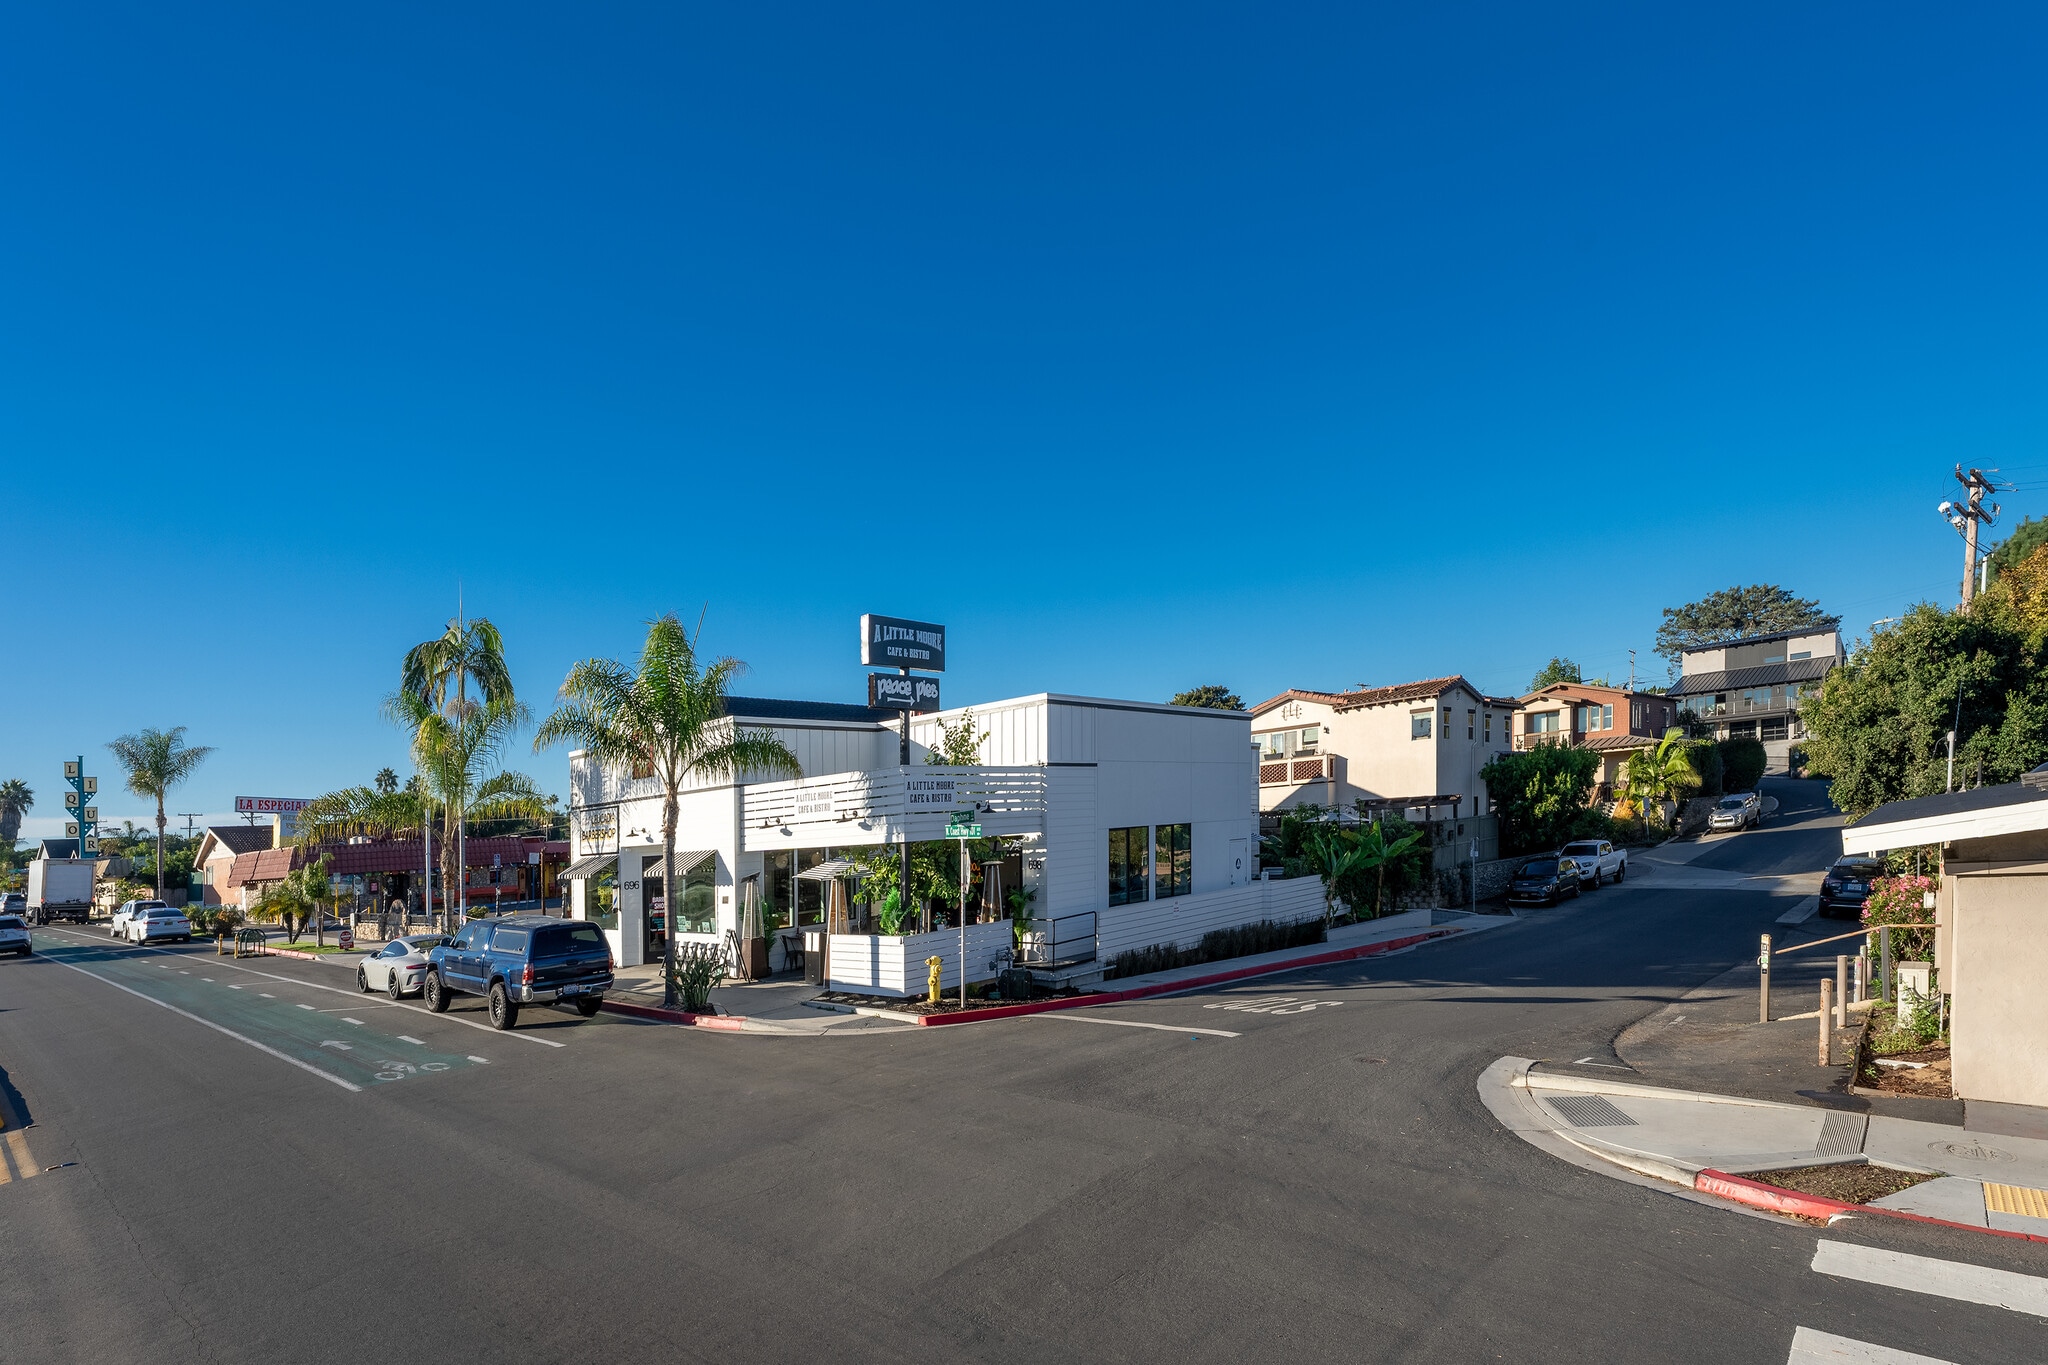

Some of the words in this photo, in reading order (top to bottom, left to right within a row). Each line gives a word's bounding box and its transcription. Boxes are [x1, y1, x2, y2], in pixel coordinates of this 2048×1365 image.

[874, 625, 881, 643] A
[883, 626, 914, 641] LITTLE
[916, 630, 942, 652] MOORE
[887, 646, 903, 657] CAFE
[903, 648, 909, 658] &
[909, 648, 930, 660] BISTRO
[877, 678, 912, 700] peace
[915, 680, 939, 702] pies
[907, 782, 911, 790] A
[911, 781, 935, 790] LITTLE
[935, 780, 955, 790] MOORE
[800, 792, 817, 802] LITTLE
[817, 790, 833, 801] MOORE
[909, 793, 925, 803] CAFE
[926, 794, 930, 802] &
[931, 793, 952, 803] BISTRO
[239, 799, 253, 810] LA
[798, 804, 810, 814] CAFE
[813, 802, 831, 813] BISTRO
[951, 813, 970, 823] Daphne
[624, 880, 640, 891] 696
